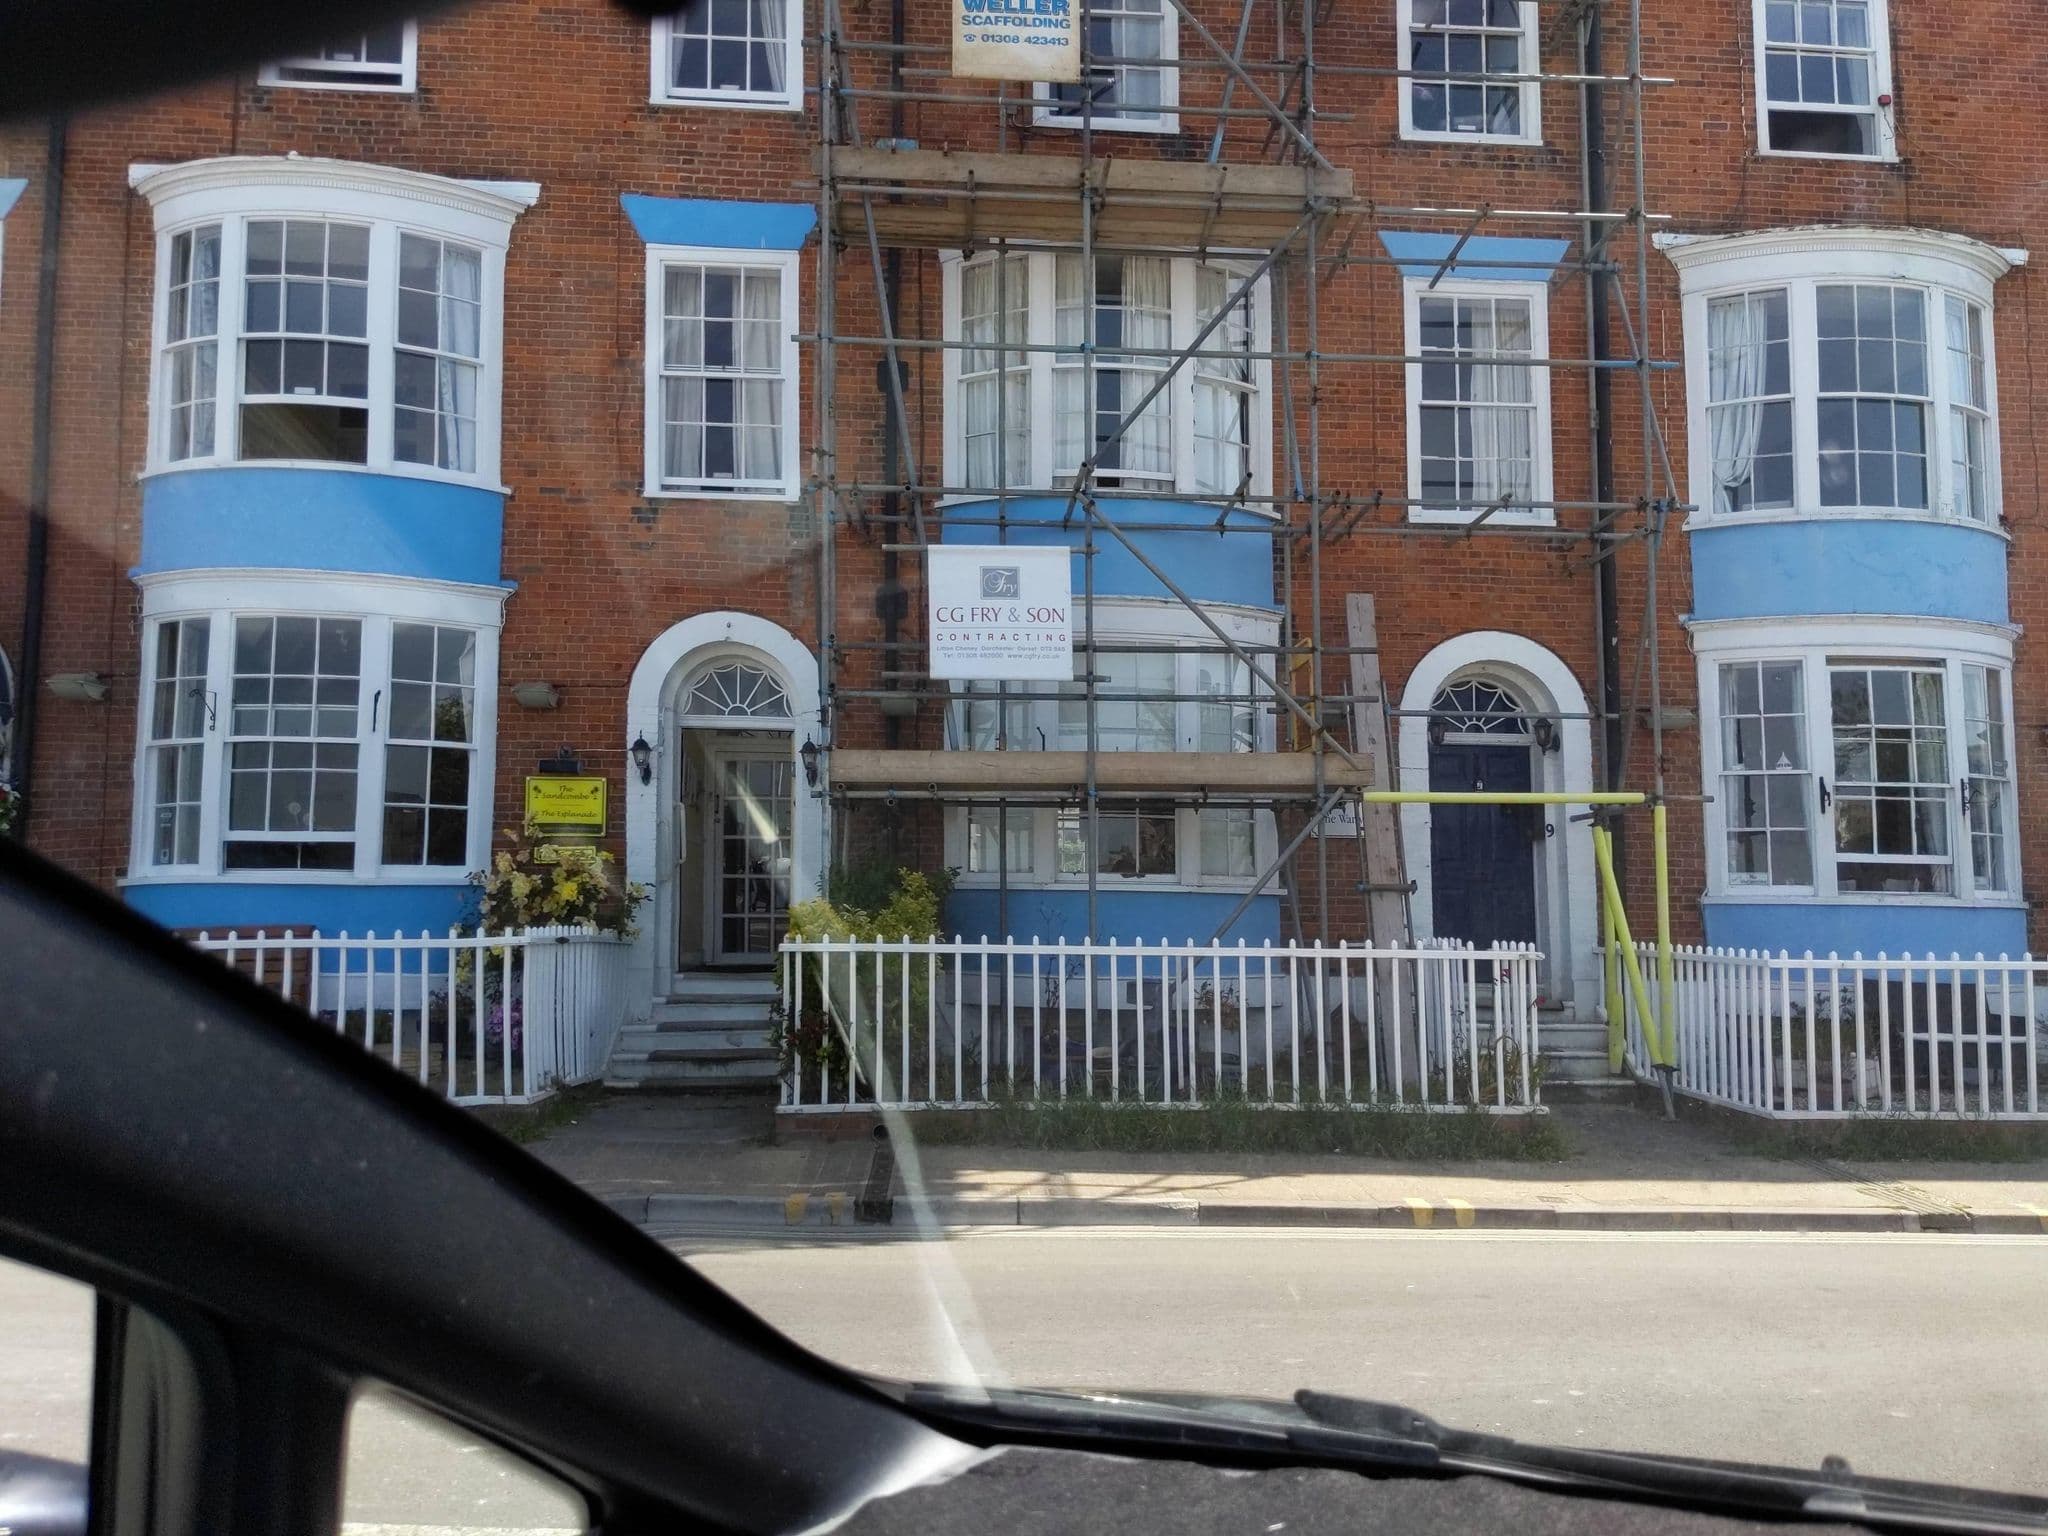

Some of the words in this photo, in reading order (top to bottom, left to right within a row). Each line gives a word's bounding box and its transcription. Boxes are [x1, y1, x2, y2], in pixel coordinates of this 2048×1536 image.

[963, 0, 1071, 16] WELLER
[961, 15, 1071, 29] SCAFFOLDING
[981, 33, 1020, 44] 01308
[1024, 36, 1069, 46] 423413
[936, 606, 964, 623] CG
[970, 607, 1001, 623] FRY
[1007, 607, 1021, 623] &
[1026, 607, 1065, 624] SON
[936, 633, 1066, 642] CONTRACTING
[560, 784, 575, 793] The
[1545, 823, 1555, 838] 9
